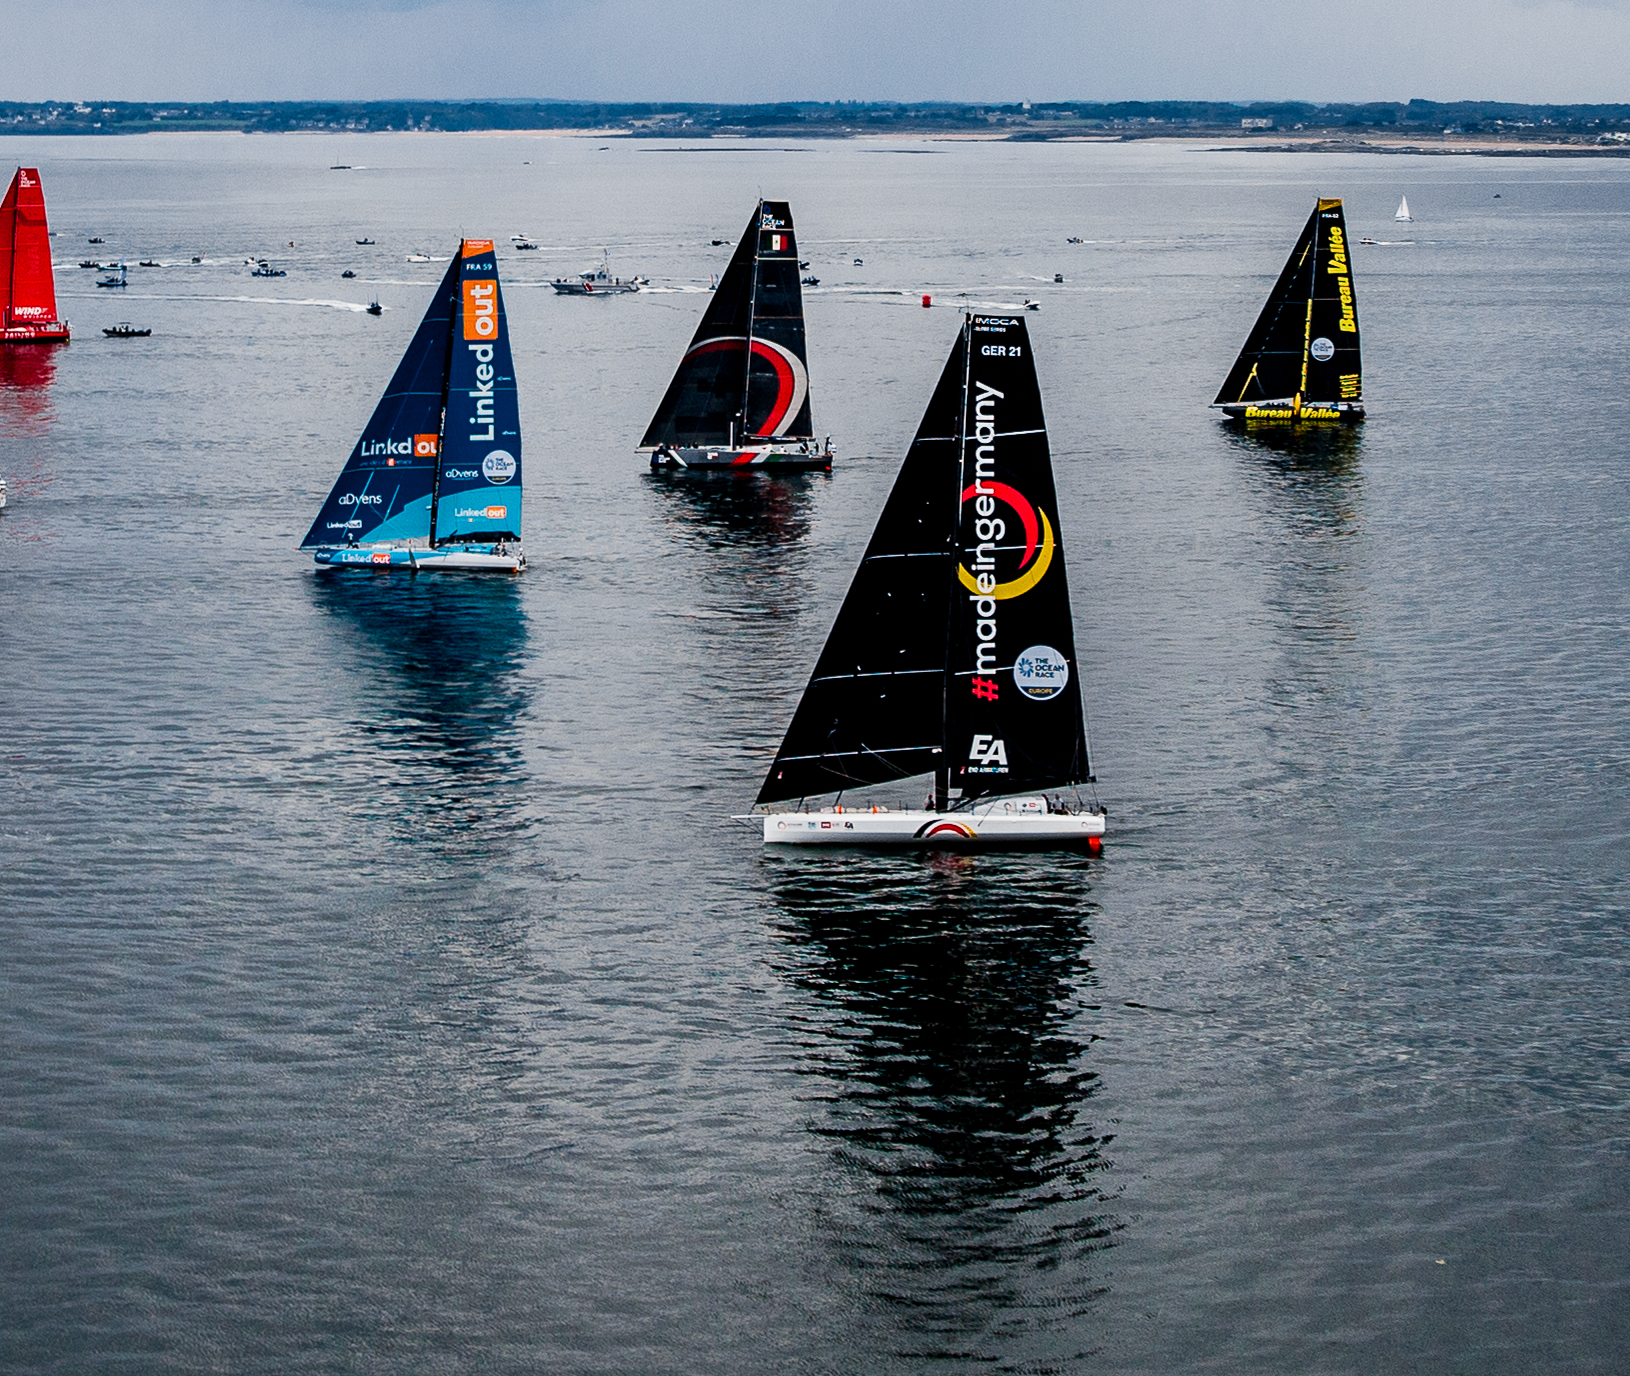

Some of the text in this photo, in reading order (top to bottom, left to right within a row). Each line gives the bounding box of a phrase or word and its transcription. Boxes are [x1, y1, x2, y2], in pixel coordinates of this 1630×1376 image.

[466, 263, 482, 271] FRA
[1327, 226, 1357, 333] Bureau Vallée
[14, 306, 42, 316] WIND
[975, 317, 1020, 326] IMOCA
[981, 345, 1021, 357] GER 21
[1245, 406, 1341, 419] Bureau Vallée
[970, 380, 1005, 702] #madeingermany
[1035, 664, 1064, 672] OCEAN
[1035, 671, 1054, 679] RACE
[969, 734, 1008, 765] EA
